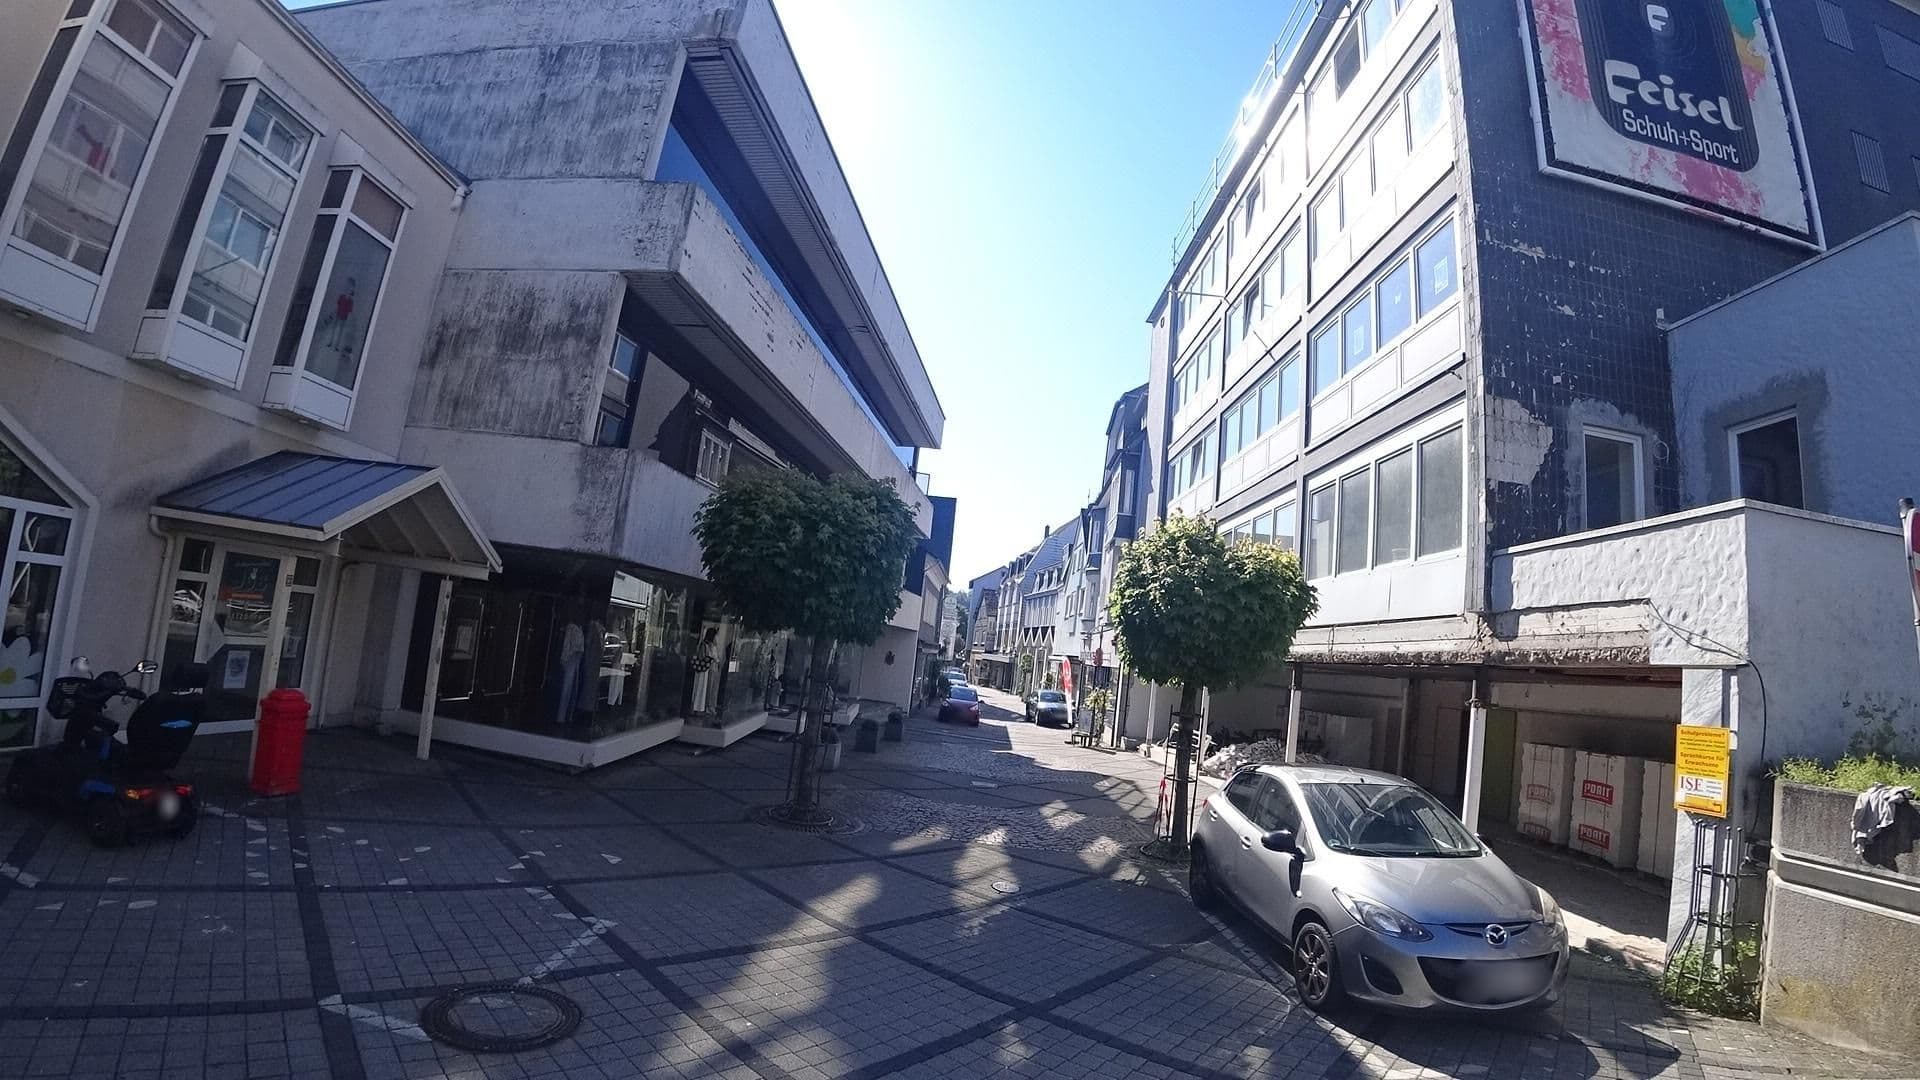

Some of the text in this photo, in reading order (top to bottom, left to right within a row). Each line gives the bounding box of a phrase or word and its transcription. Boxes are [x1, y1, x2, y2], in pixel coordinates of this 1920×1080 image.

[1604, 59, 1744, 131] Feisel
[1622, 109, 1739, 164] Schuh+Sport
[1584, 783, 1612, 798] PORIT
[1680, 776, 1704, 793] ISE
[1580, 826, 1608, 843] PORIT
